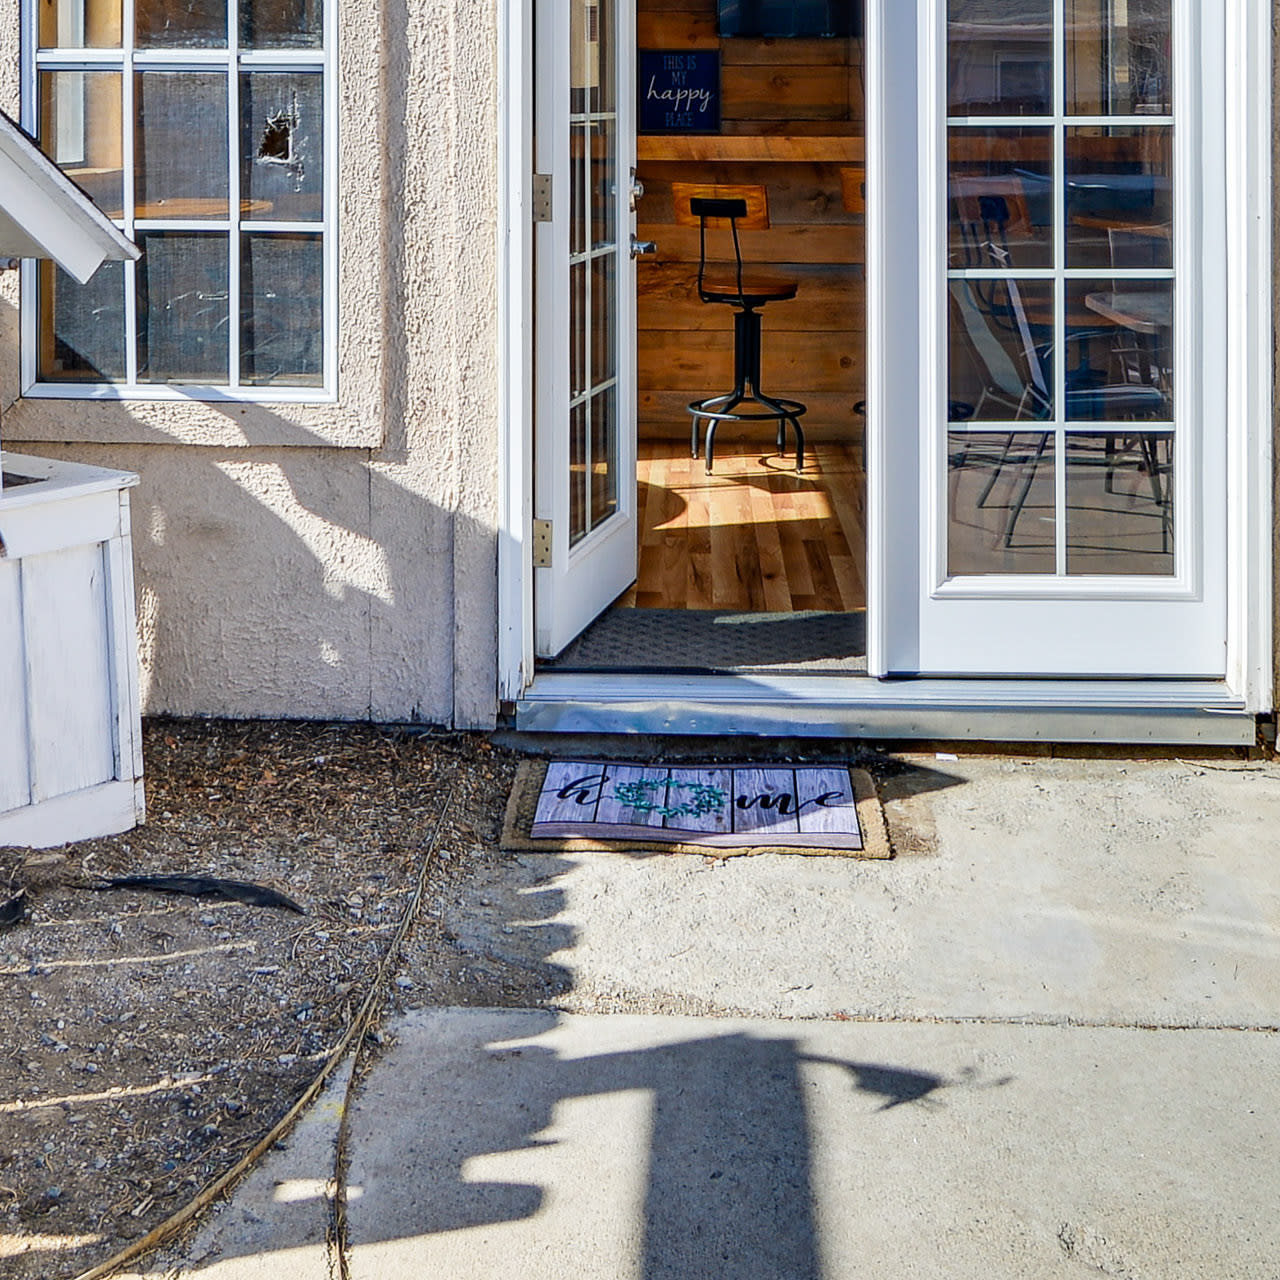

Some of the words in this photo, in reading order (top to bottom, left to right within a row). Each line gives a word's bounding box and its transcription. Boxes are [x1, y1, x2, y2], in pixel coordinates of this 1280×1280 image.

[663, 55, 684, 71] THIS
[687, 55, 697, 71] IS
[671, 71, 687, 86] MY
[647, 74, 713, 113] happy
[665, 111, 695, 128] PLACE
